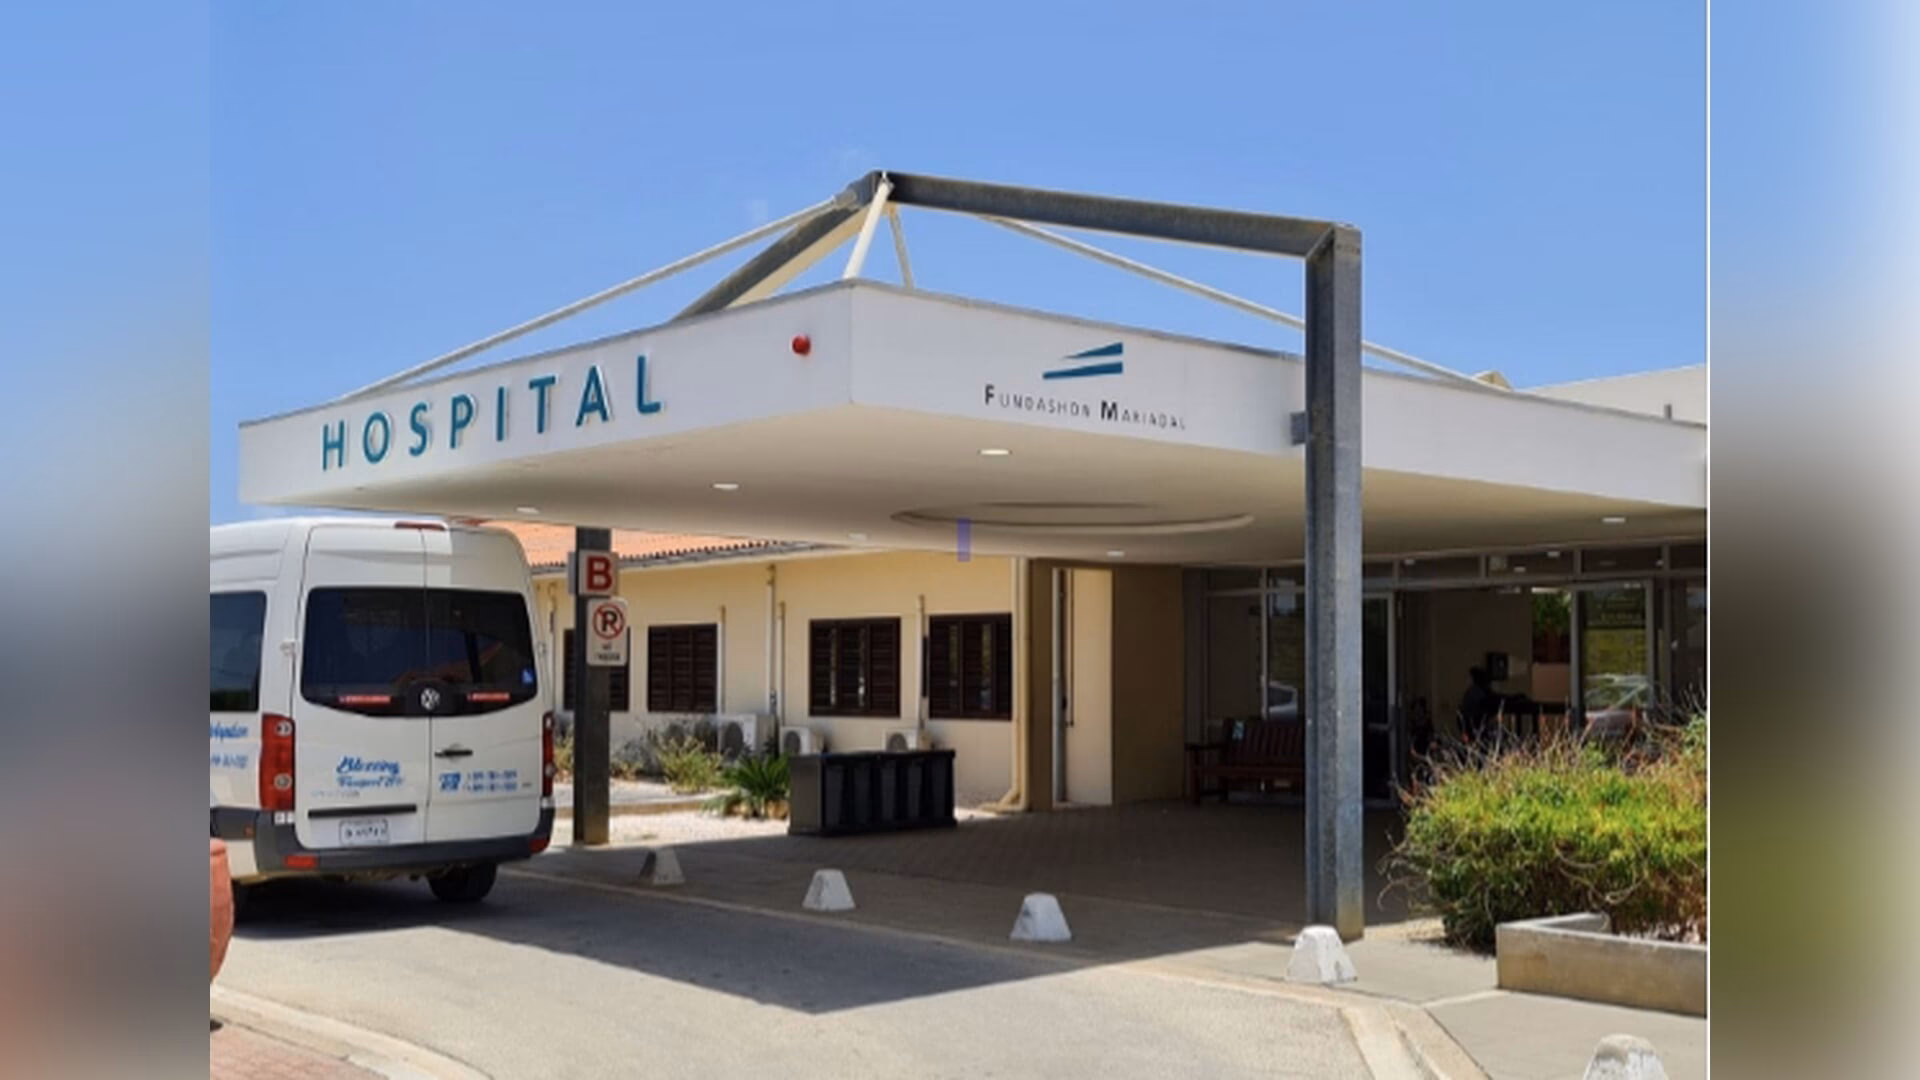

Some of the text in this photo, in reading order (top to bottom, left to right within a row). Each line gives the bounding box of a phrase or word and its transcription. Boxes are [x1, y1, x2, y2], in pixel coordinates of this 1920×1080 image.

[322, 355, 662, 471] HOSPITAL
[984, 384, 1091, 418] FUNDASHON
[586, 556, 612, 591] B
